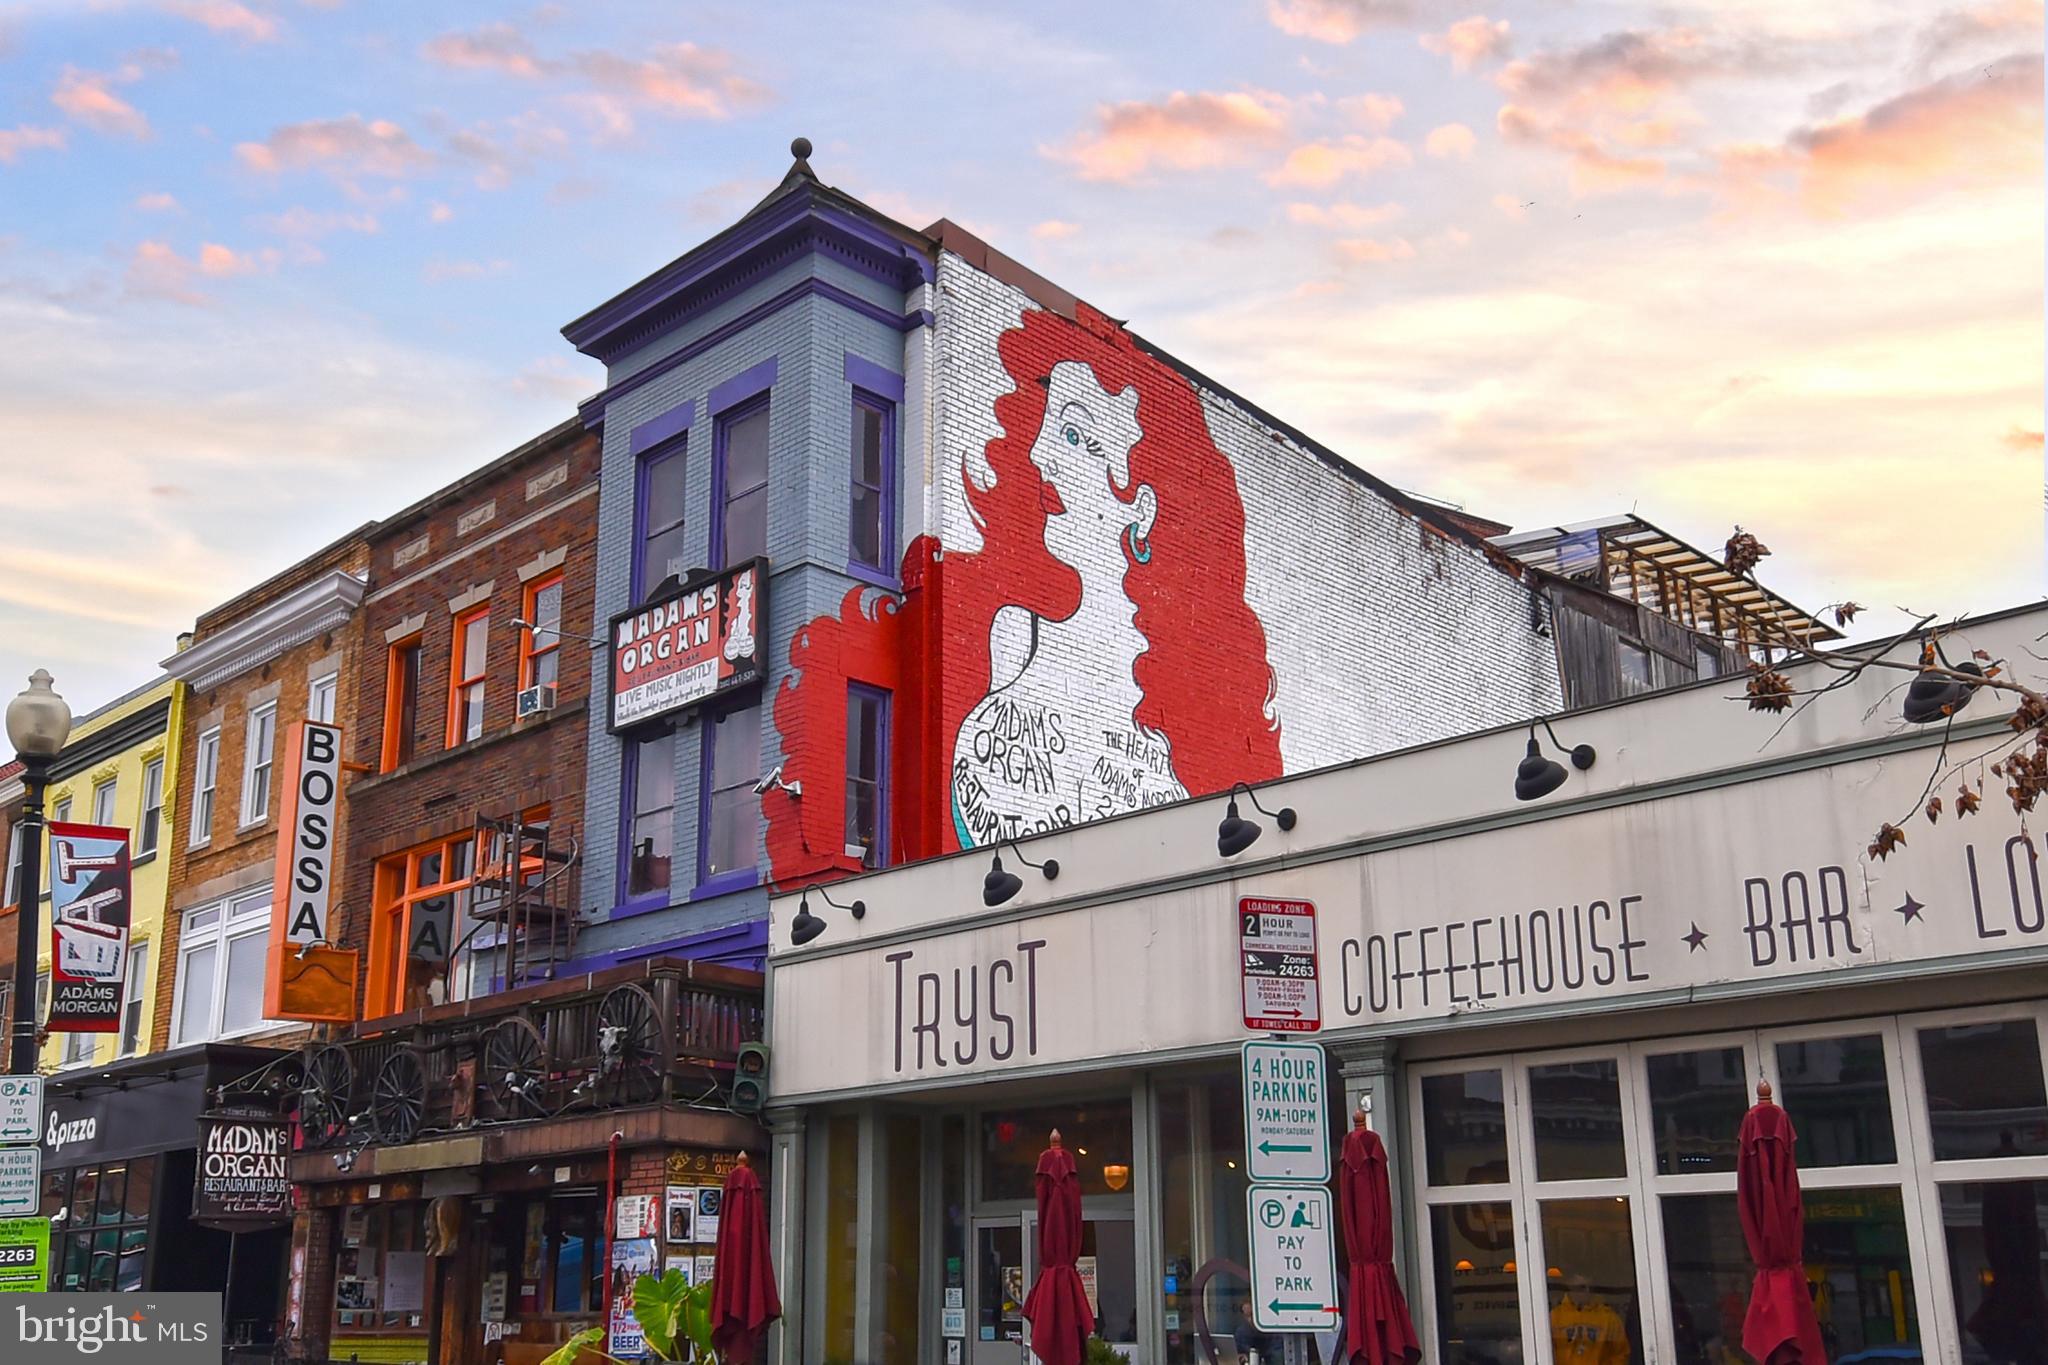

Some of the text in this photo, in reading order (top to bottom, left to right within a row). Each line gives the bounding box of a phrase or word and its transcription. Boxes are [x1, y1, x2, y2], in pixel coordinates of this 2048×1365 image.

[622, 617, 709, 673] ORGAN
[618, 688, 642, 708] LIVE
[646, 676, 673, 698] MUSIC
[676, 661, 713, 686] NIGHTLY
[976, 696, 1065, 754] MADAM'S
[974, 730, 1056, 794] ORGAN
[1102, 730, 1170, 775] THE HEART
[1092, 756, 1136, 808] ADAMS
[1132, 768, 1145, 786] OF
[289, 726, 335, 938] BOSSA
[56, 840, 127, 981] EAT
[1247, 901, 1307, 914] LOADING ZONE
[1245, 915, 1294, 935] 2 HOUR
[885, 832, 2048, 1072] TRYST COFFEEHOUSE BAR LO
[1283, 954, 1311, 965] Zone:
[1279, 965, 1314, 977] 24263
[60, 986, 114, 1000] ADAMS
[53, 1001, 118, 1013] MORGAN
[1283, 1020, 1300, 1029] CALL
[1252, 1057, 1316, 1080] 4 HOUR
[1252, 1081, 1317, 1103] PARKING
[1257, 1108, 1316, 1123] 9AM-10PM
[46, 1111, 96, 1152] &pizza
[207, 1125, 288, 1154] MADAM'S
[8, 1155, 33, 1164] HOUR
[205, 1154, 286, 1178] ORGAN
[0, 1179, 34, 1188] AM-10PM
[1277, 1236, 1305, 1249] PAY
[1284, 1256, 1302, 1270] TO
[1275, 1277, 1313, 1291] PARK
[612, 1322, 627, 1334] 1/2
[613, 1335, 640, 1348] BEER
